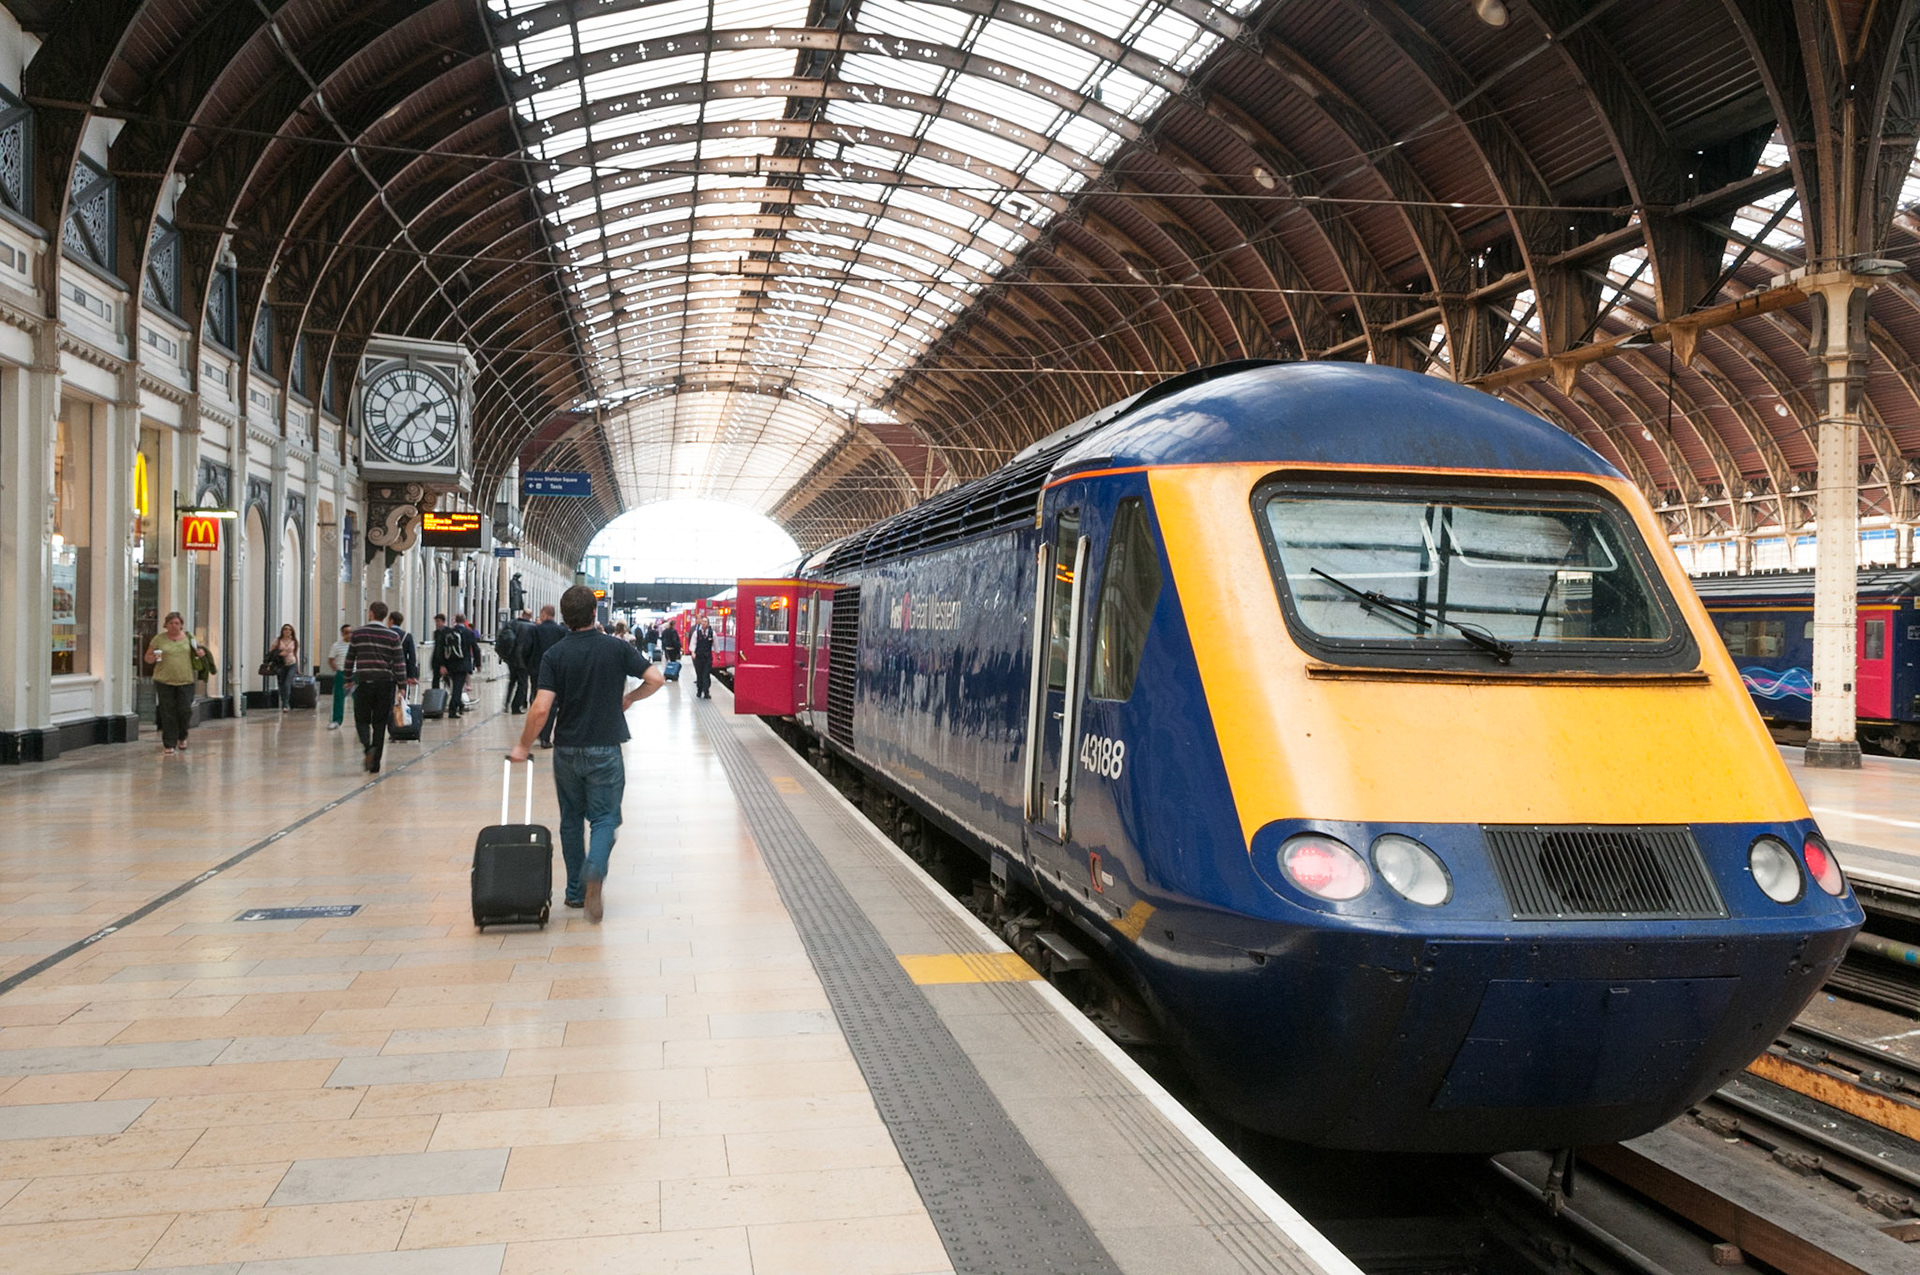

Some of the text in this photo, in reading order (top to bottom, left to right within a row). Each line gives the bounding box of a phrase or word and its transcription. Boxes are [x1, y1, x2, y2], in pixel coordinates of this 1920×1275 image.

[910, 594, 928, 630] Great
[928, 593, 961, 631] Western
[1080, 732, 1125, 780] 43188
